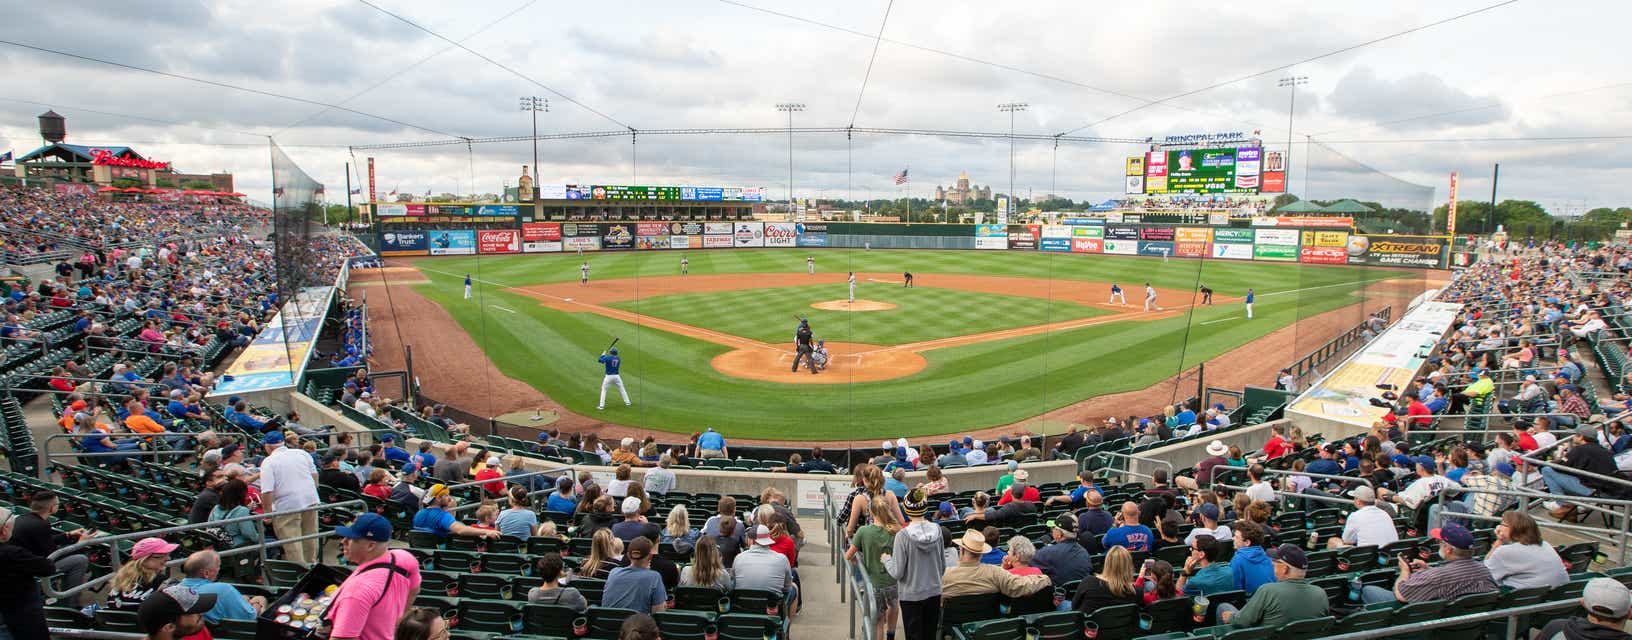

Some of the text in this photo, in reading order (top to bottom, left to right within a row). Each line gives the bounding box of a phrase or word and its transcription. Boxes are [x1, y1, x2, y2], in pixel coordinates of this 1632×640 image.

[1216, 131, 1244, 140] PARK
[88, 148, 169, 169] Budweiser
[765, 225, 797, 238] Coors
[1372, 242, 1440, 254] XTREAM
